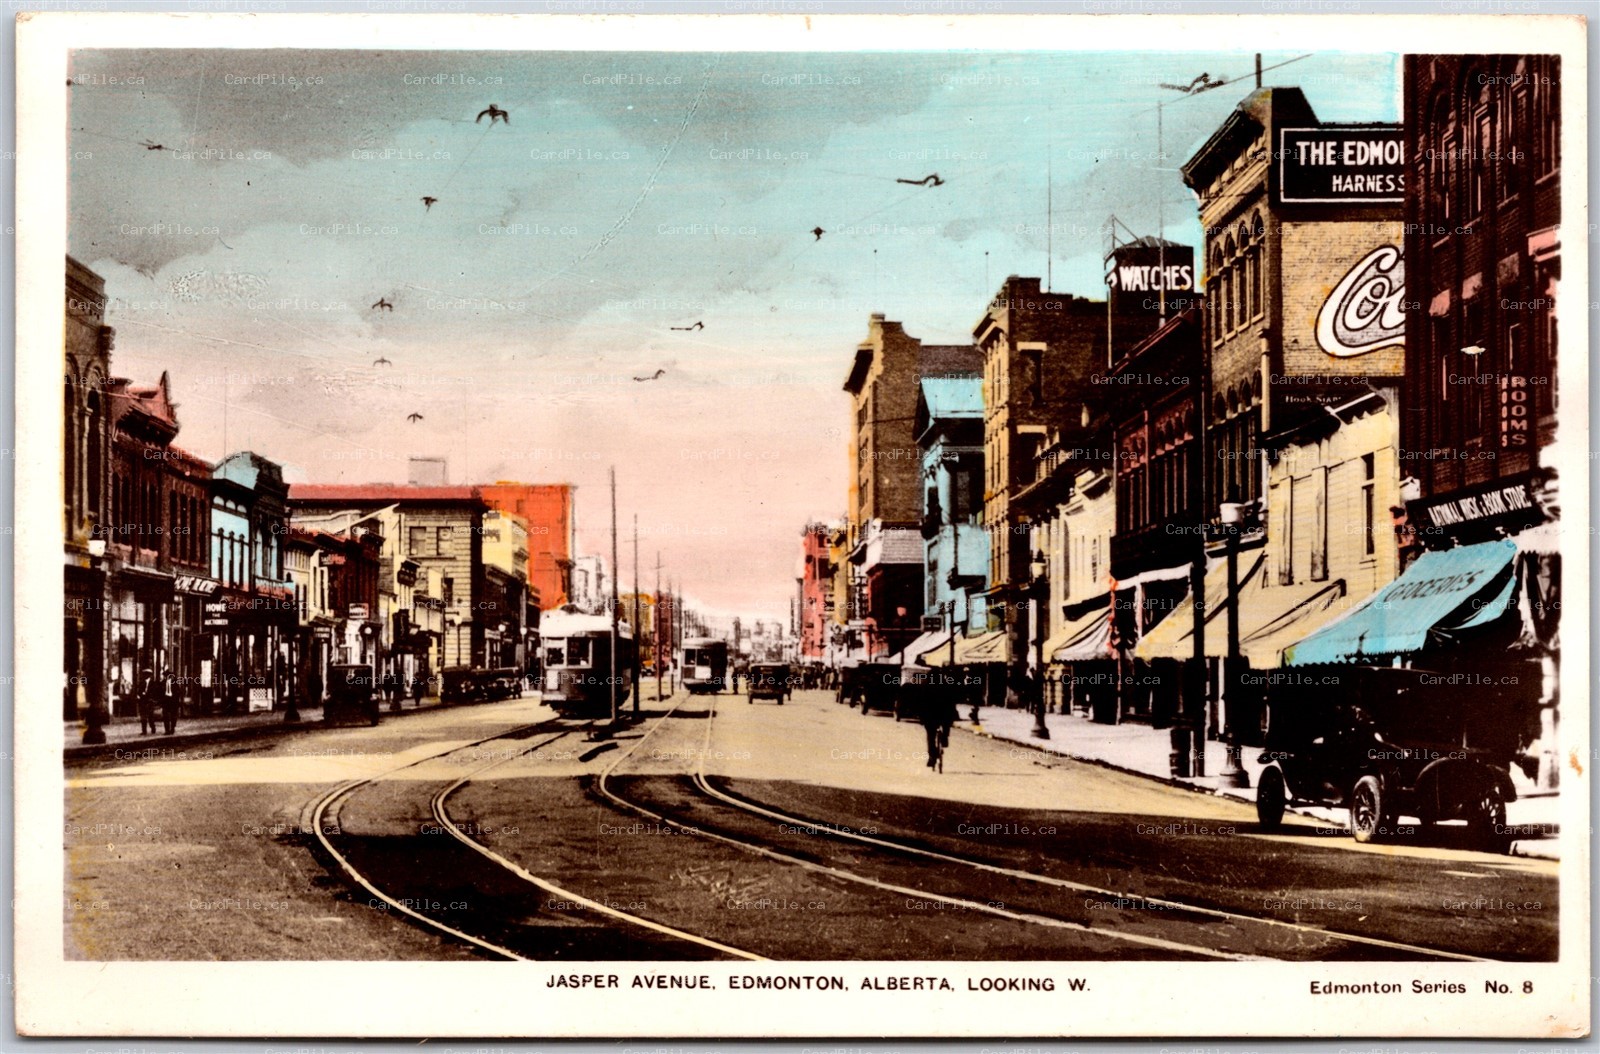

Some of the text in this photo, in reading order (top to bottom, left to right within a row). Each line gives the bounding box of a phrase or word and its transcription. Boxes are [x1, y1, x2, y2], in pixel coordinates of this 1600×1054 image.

[1296, 140, 1404, 166] THE EDMO
[1119, 265, 1192, 291] WATCHES
[1511, 376, 1527, 445] ROOMS
[205, 603, 226, 612] HOWE
